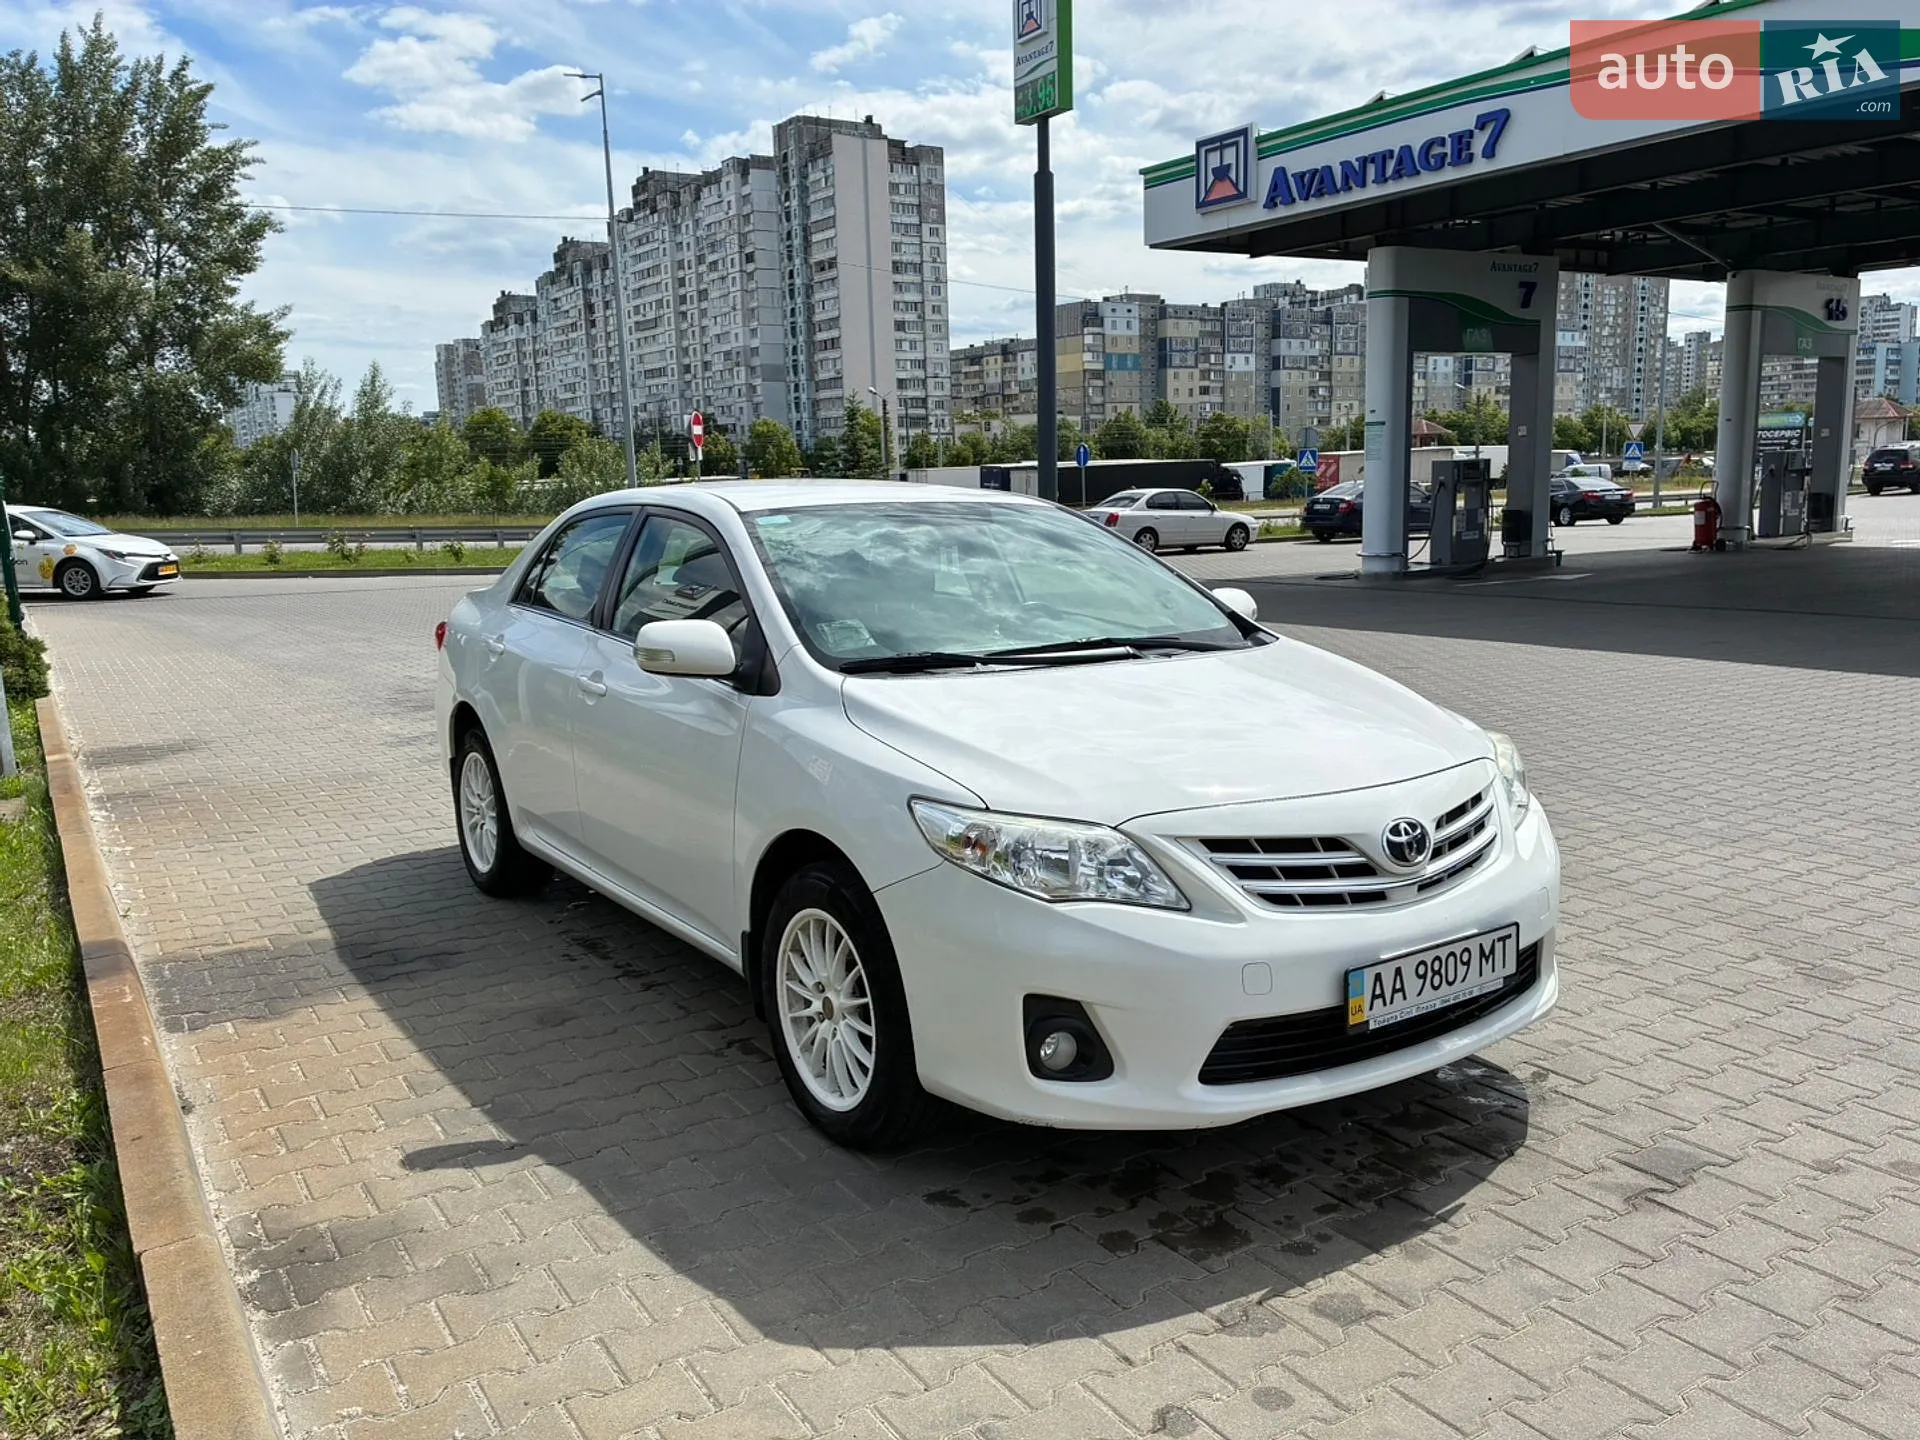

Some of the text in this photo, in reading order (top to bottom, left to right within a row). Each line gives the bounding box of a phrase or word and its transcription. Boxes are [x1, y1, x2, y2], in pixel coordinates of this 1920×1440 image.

[1263, 108, 1512, 209] AVANTAGE7
[1519, 281, 1537, 309] 7
[1369, 933, 1512, 1011] AA 9809 MT
[1351, 1005, 1364, 1016] UA
